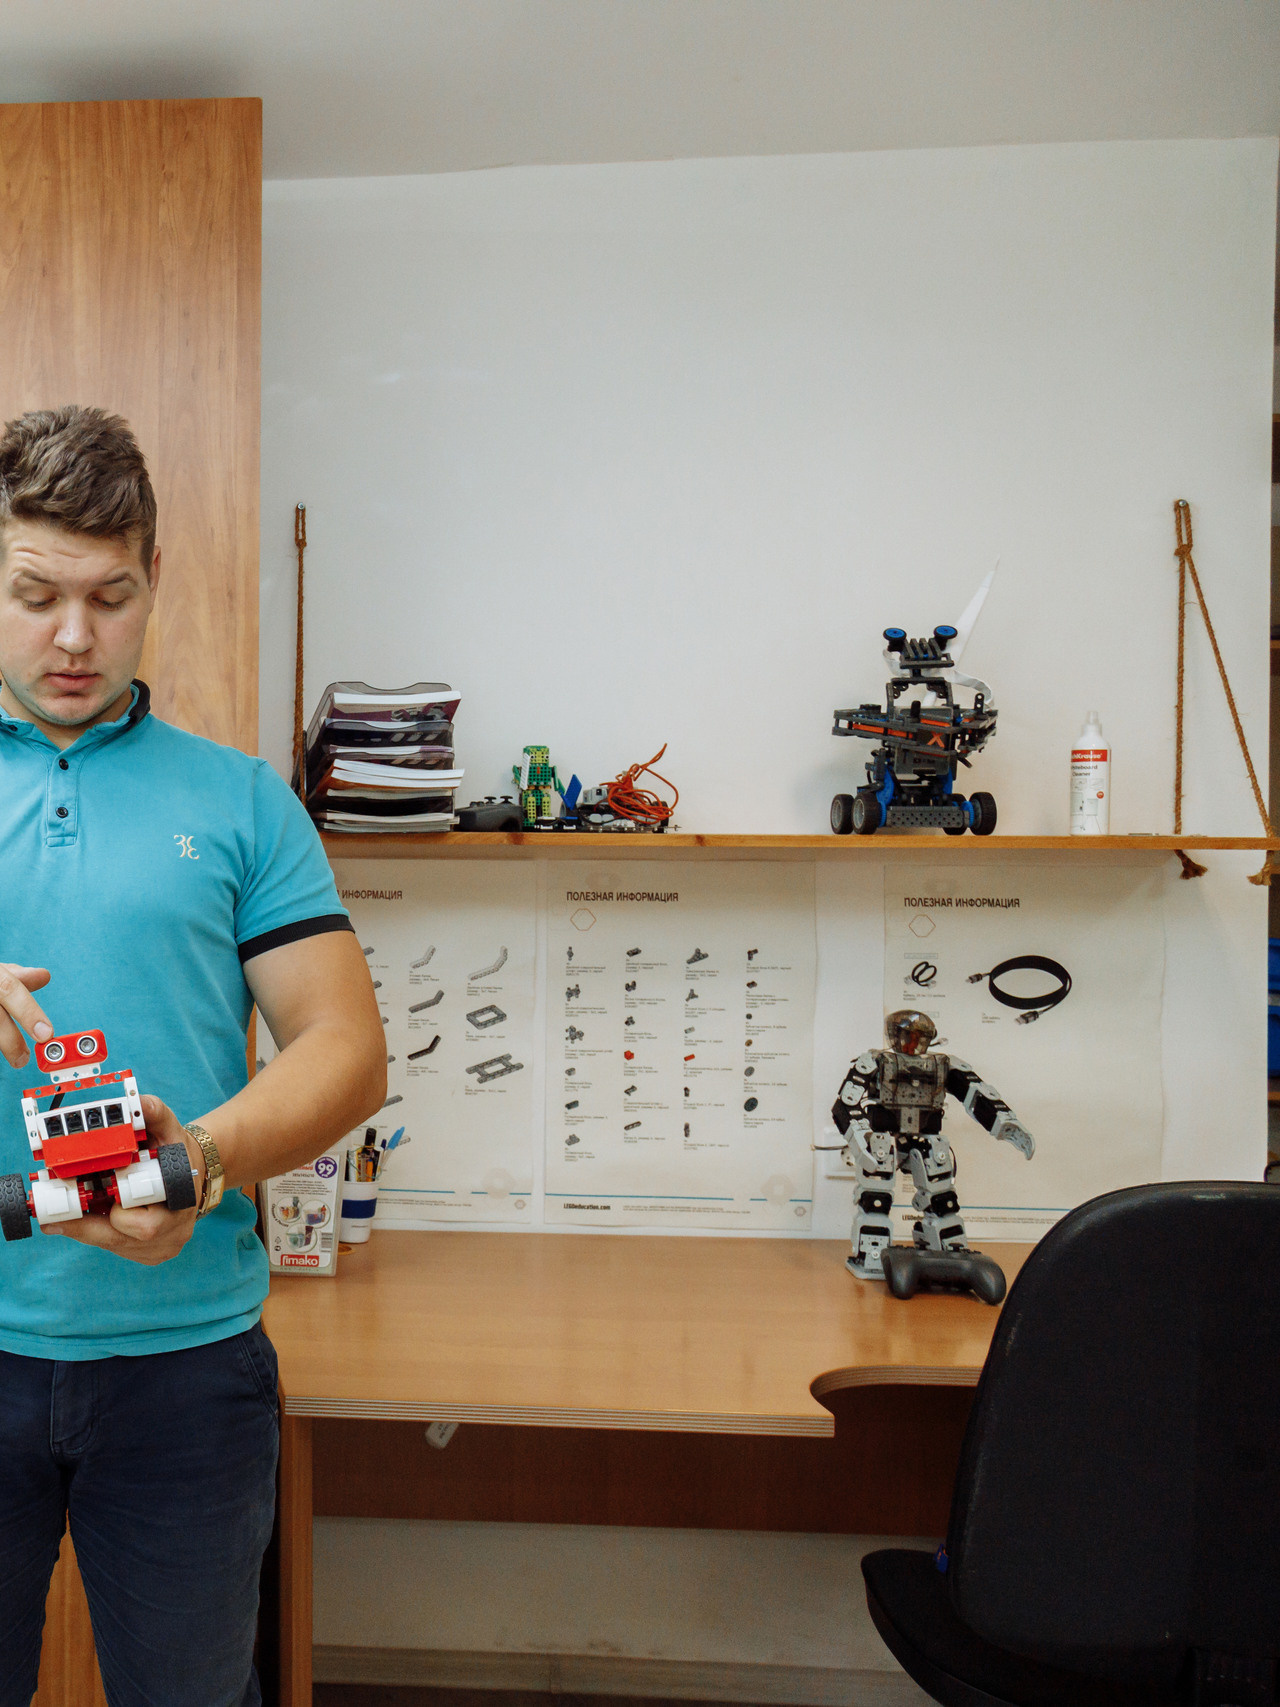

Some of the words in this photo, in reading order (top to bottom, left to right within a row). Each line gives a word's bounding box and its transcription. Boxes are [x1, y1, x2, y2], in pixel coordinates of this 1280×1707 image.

[341, 889, 403, 901] ИНФОРМАЦИЯ
[566, 891, 614, 902] ПОЛЕЗНАЯ
[616, 892, 679, 903] ИНФОРМАЦИЯ
[904, 897, 953, 907] ПОЛЕЗНАЯ
[955, 898, 1020, 909] ИНФОРМАЦИЯ
[317, 1162, 335, 1175] 99
[563, 1203, 611, 1211] LEGOeducation.com
[281, 1255, 318, 1267] fimako
